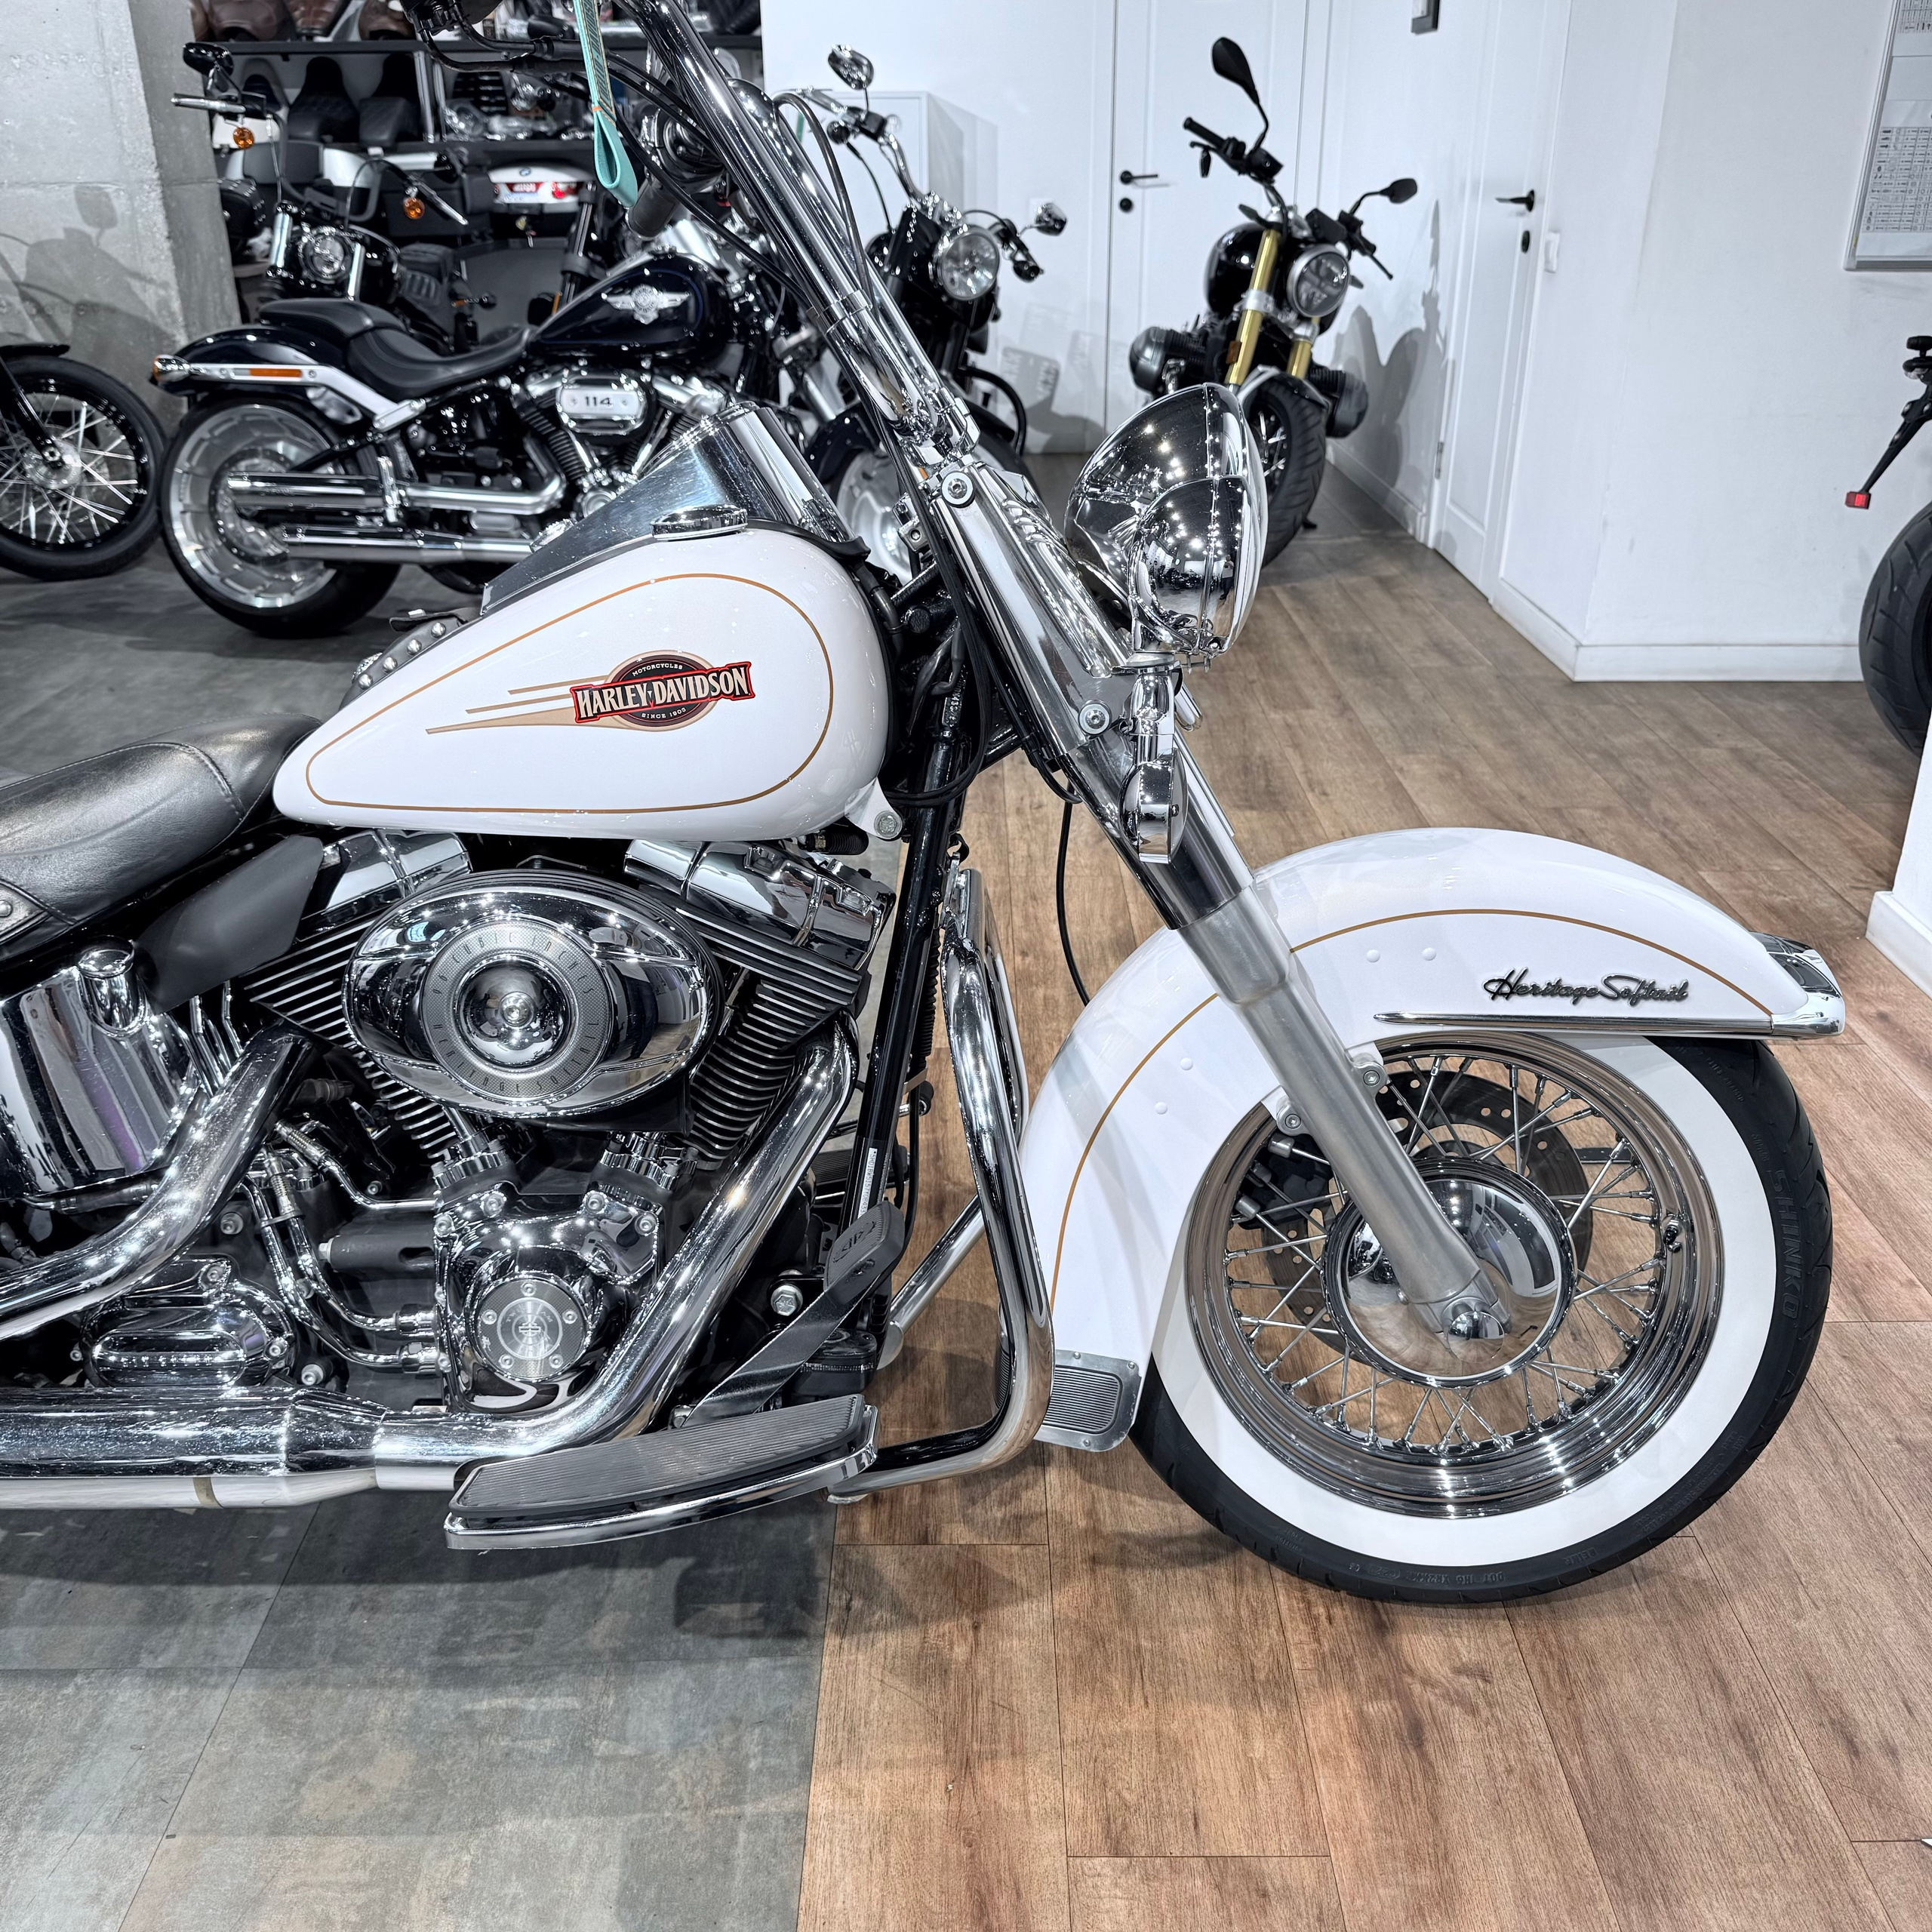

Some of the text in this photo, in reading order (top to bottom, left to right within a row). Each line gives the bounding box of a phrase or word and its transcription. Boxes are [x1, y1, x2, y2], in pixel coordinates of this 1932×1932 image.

[585, 396, 613, 406] 114
[632, 663, 682, 677] MOTORCYCLES
[575, 666, 752, 718] HARLEY-DAVIDSON
[669, 708, 687, 717] 1903
[1483, 967, 1690, 1007] Heritage Softail
[1769, 1170, 1803, 1319] SHINKO
